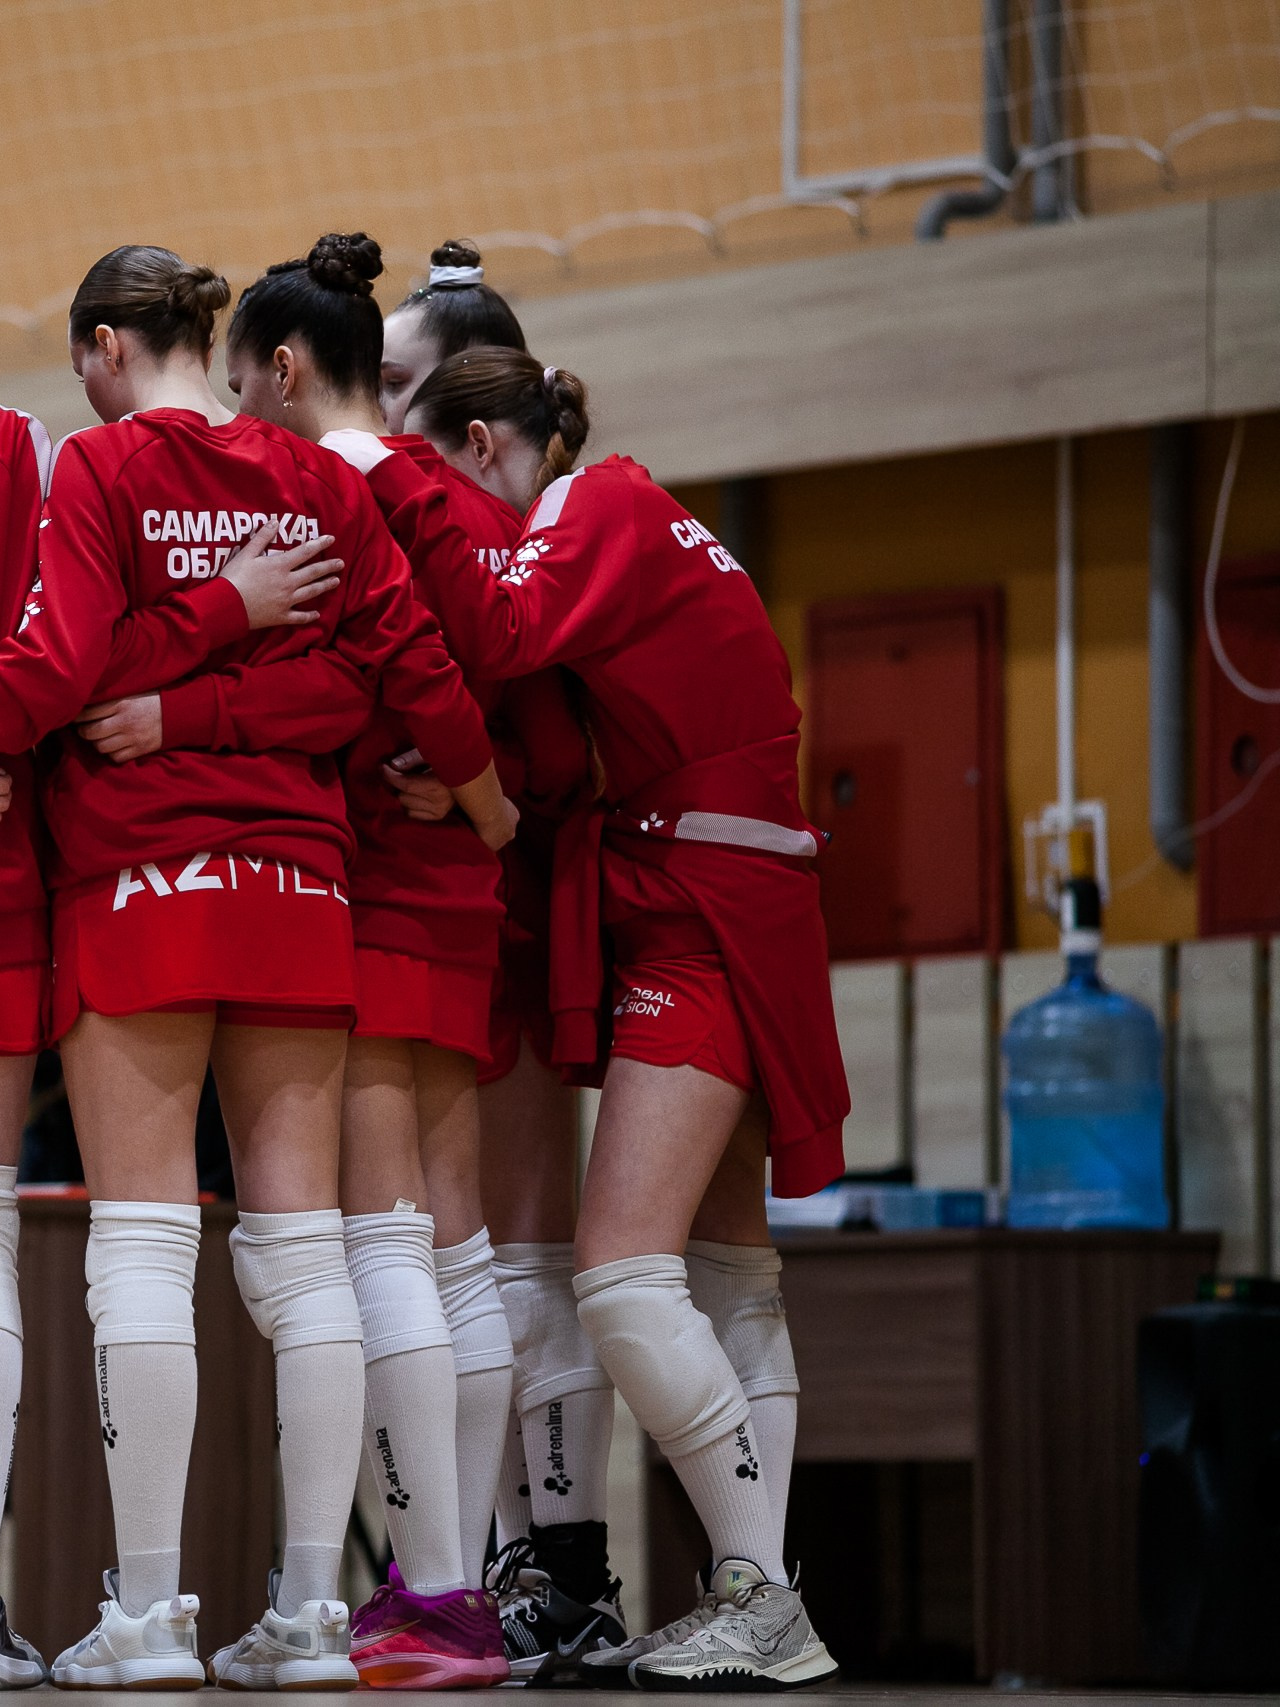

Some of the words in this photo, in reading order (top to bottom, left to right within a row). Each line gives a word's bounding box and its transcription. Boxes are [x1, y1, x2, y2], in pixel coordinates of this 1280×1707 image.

[625, 1001, 661, 1017] SION
[376, 1426, 401, 1488] adrenalina
[545, 1401, 564, 1471] adrenalina
[735, 1423, 751, 1456] adre
